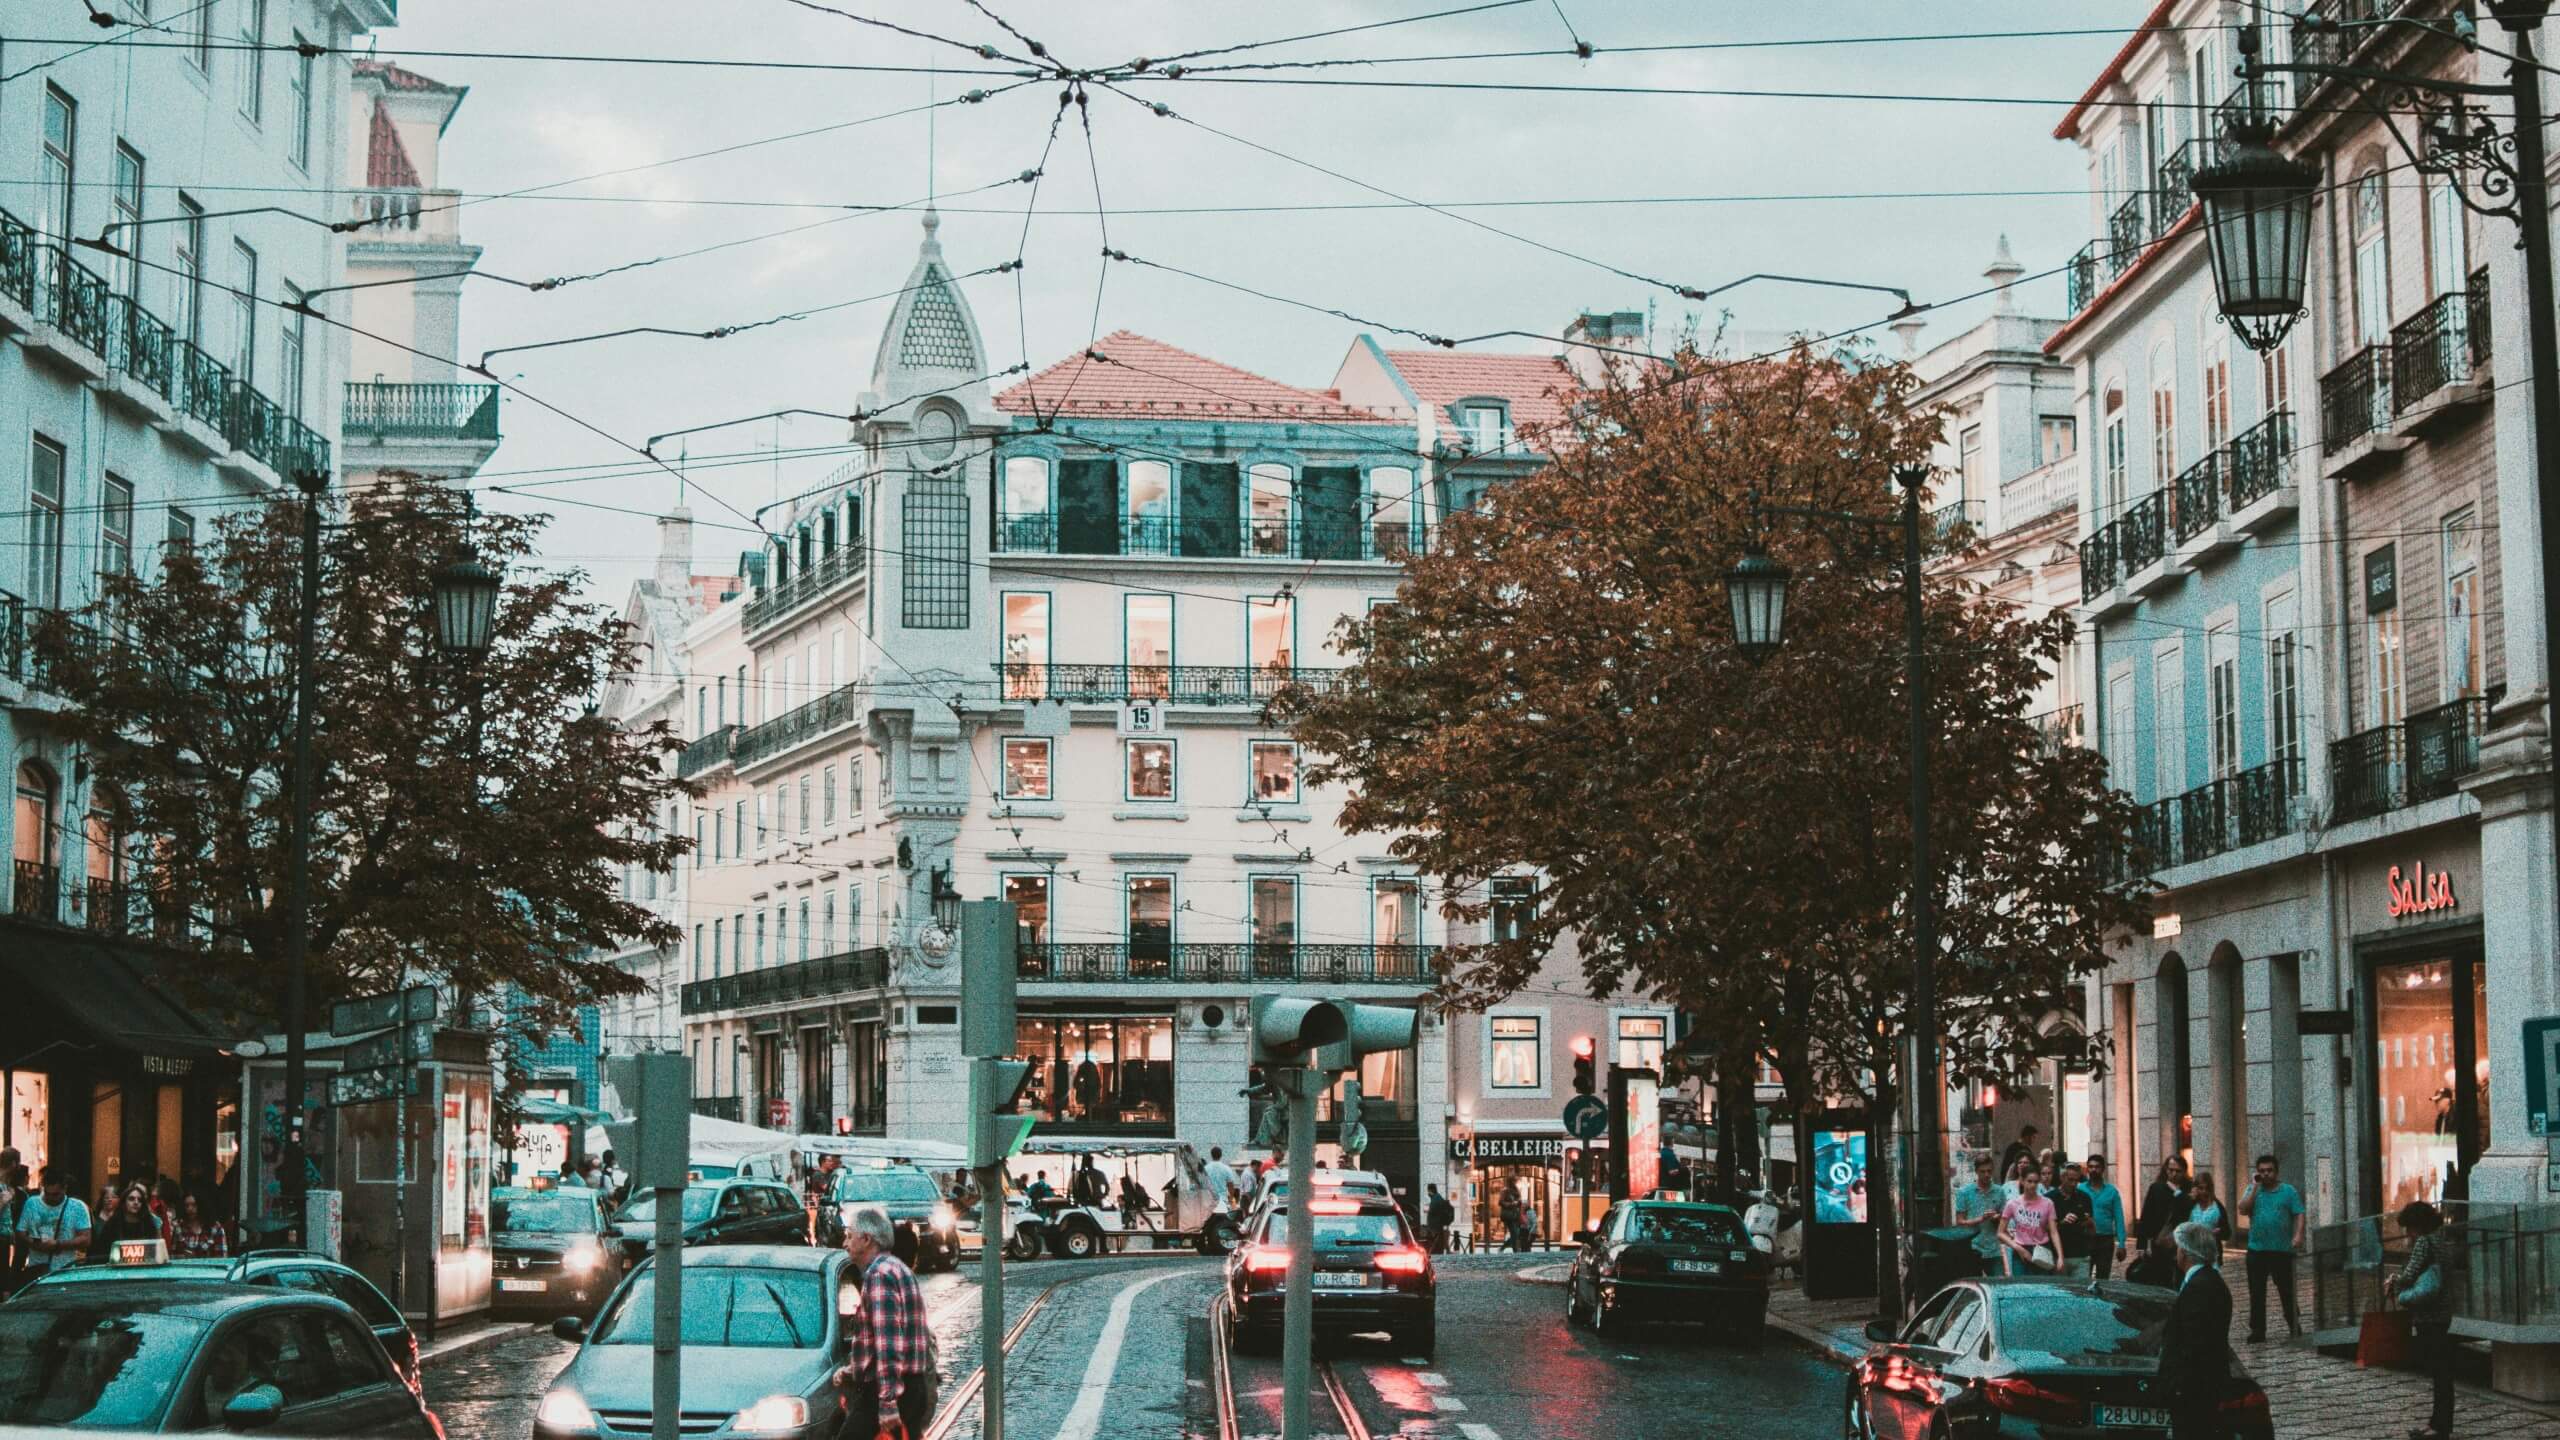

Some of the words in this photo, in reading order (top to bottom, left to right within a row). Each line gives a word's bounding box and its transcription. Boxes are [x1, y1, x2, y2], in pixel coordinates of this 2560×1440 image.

[1132, 707, 1150, 724] 15
[2387, 860, 2455, 918] Salsa
[121, 1245, 145, 1258] TAXI
